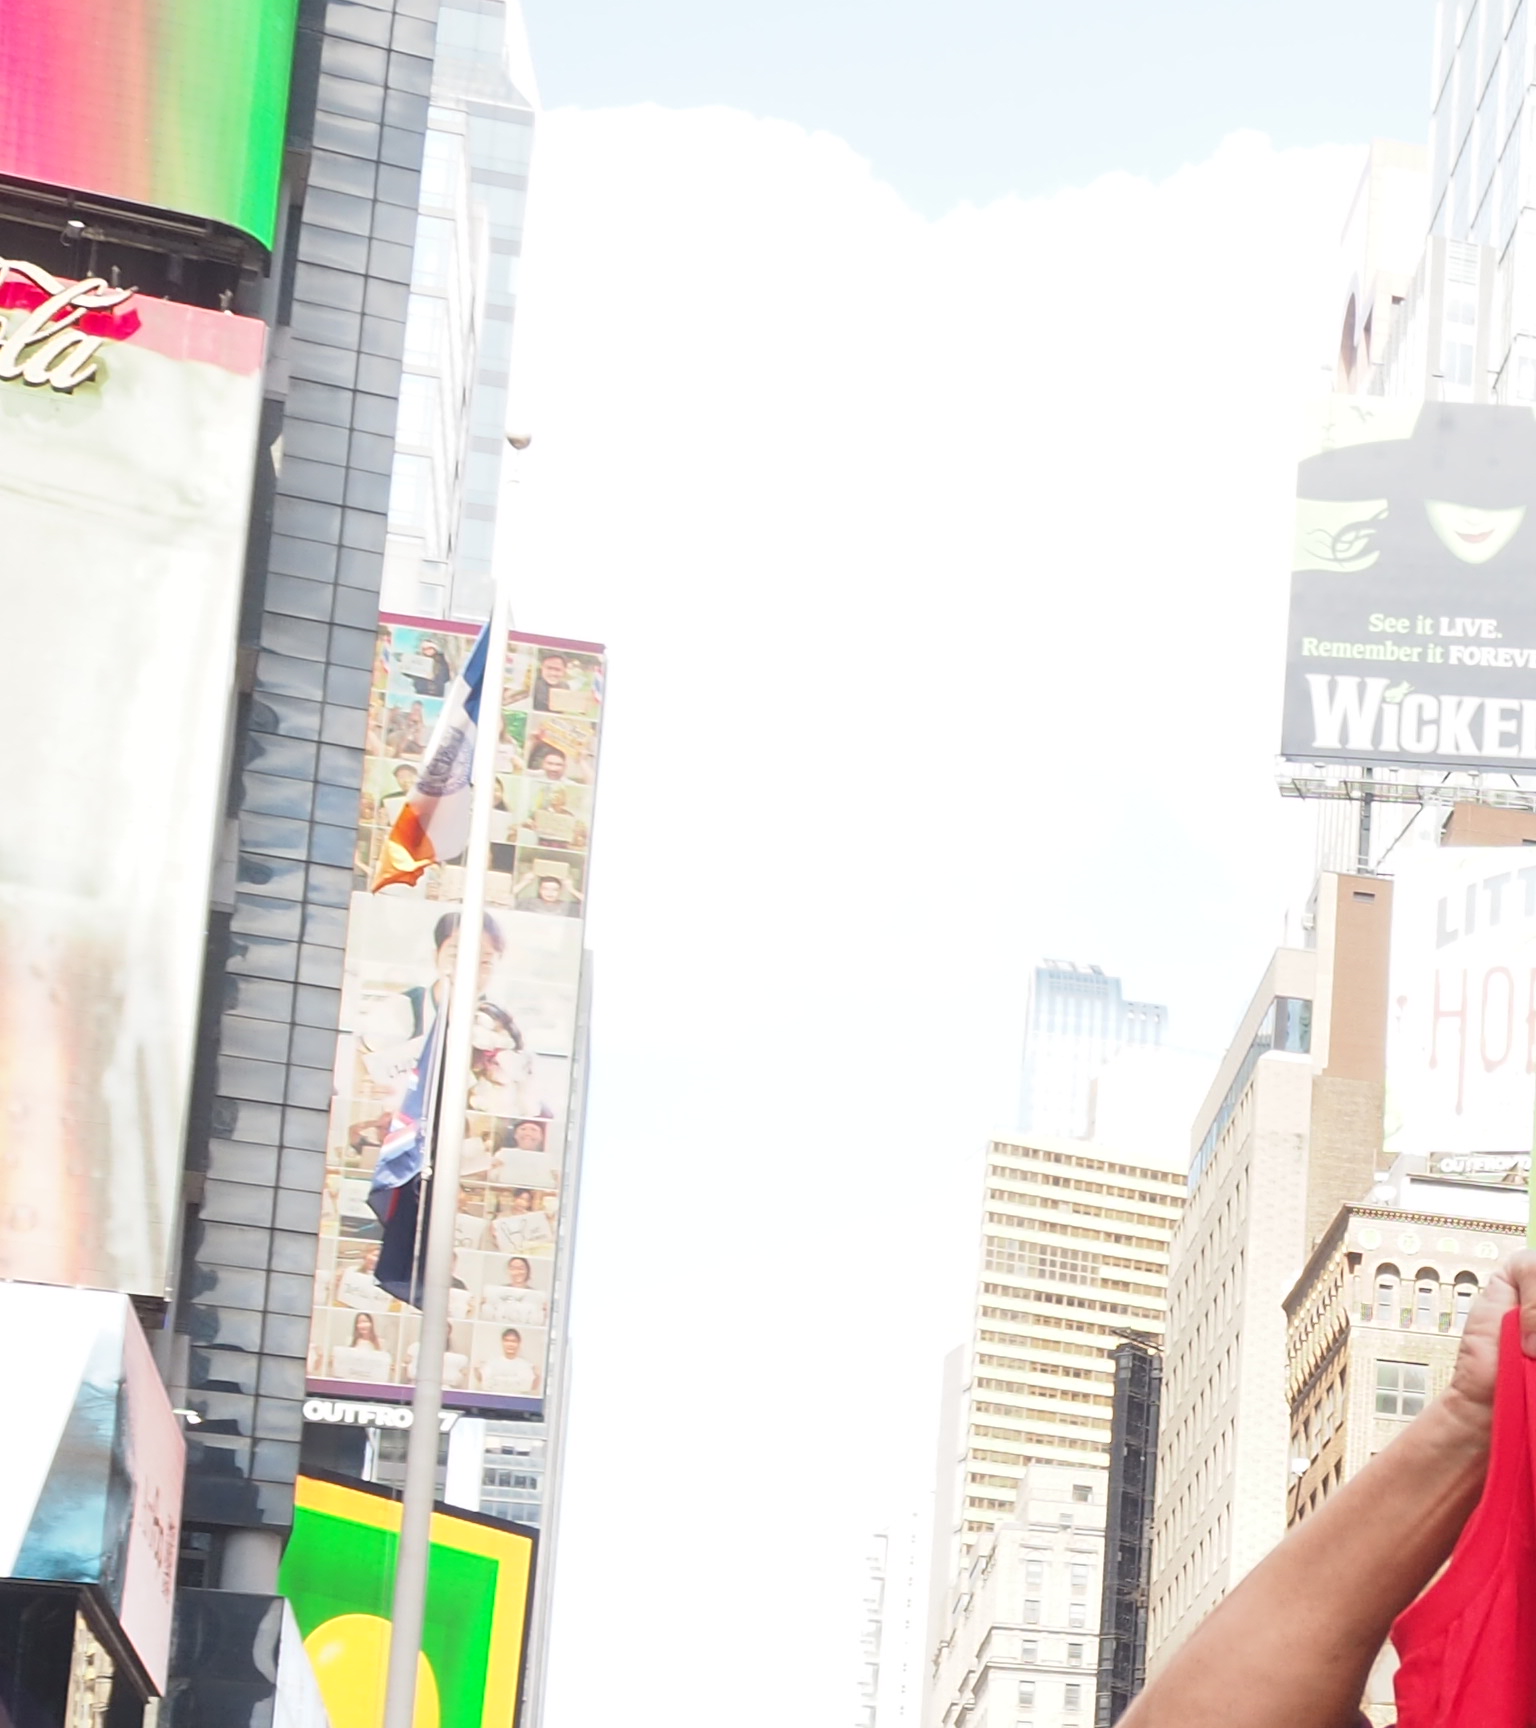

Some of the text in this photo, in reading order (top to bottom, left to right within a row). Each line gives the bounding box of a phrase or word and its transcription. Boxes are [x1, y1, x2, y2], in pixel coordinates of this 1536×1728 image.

[1369, 612, 1503, 639] See it LIVE.
[1302, 637, 1422, 663] Remember
[1426, 643, 1444, 664] it
